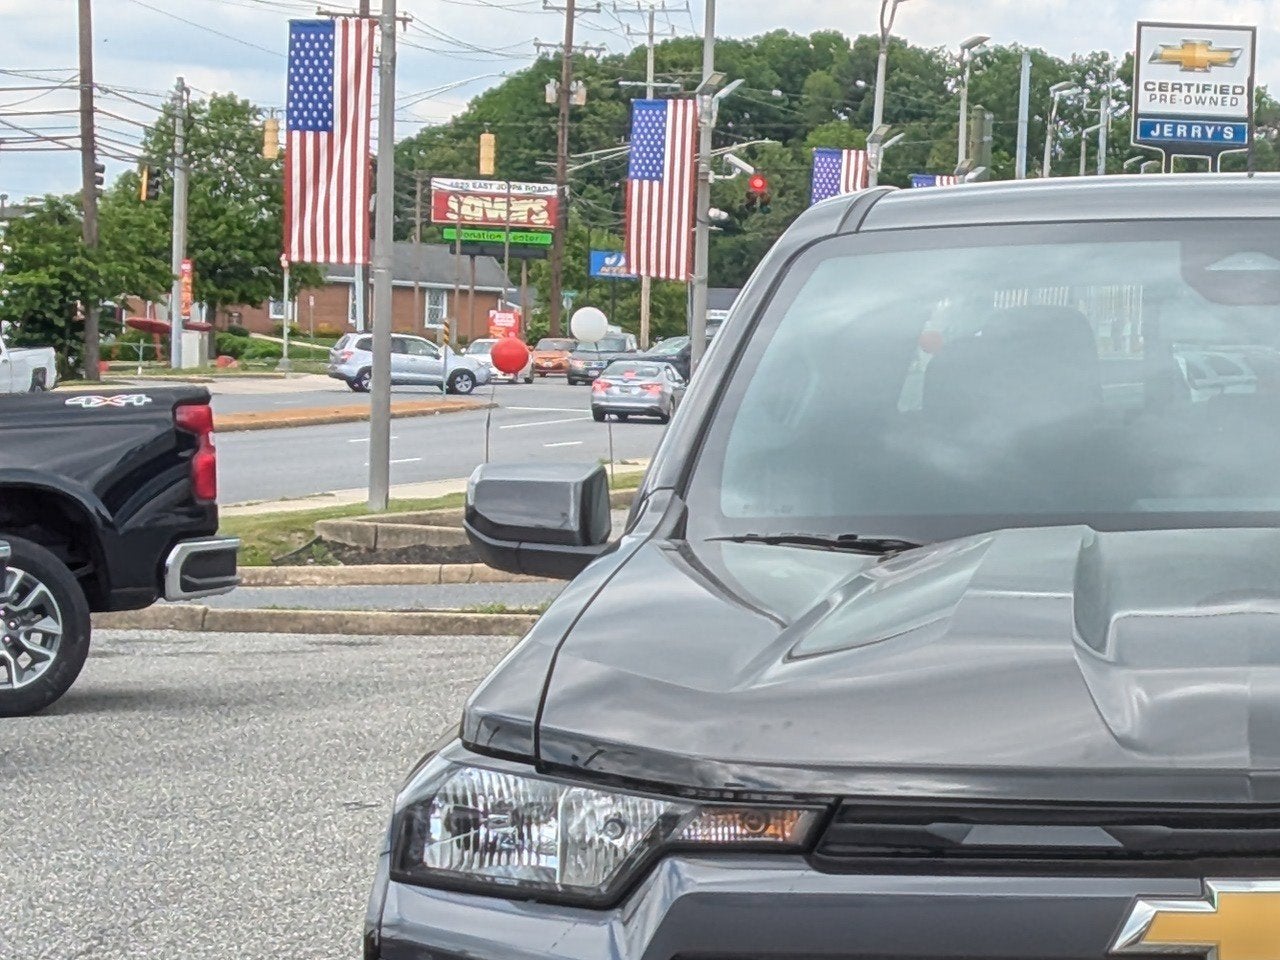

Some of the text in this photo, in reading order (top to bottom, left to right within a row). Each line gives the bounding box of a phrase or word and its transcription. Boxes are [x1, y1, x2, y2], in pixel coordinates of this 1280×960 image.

[1143, 81, 1245, 96] CERTIFIED
[1149, 93, 1239, 107] PRE-OWNED
[1150, 123, 1234, 140] JERRY'S
[472, 182, 493, 191] EAST
[525, 185, 549, 193] ROAD
[457, 231, 502, 240] onation
